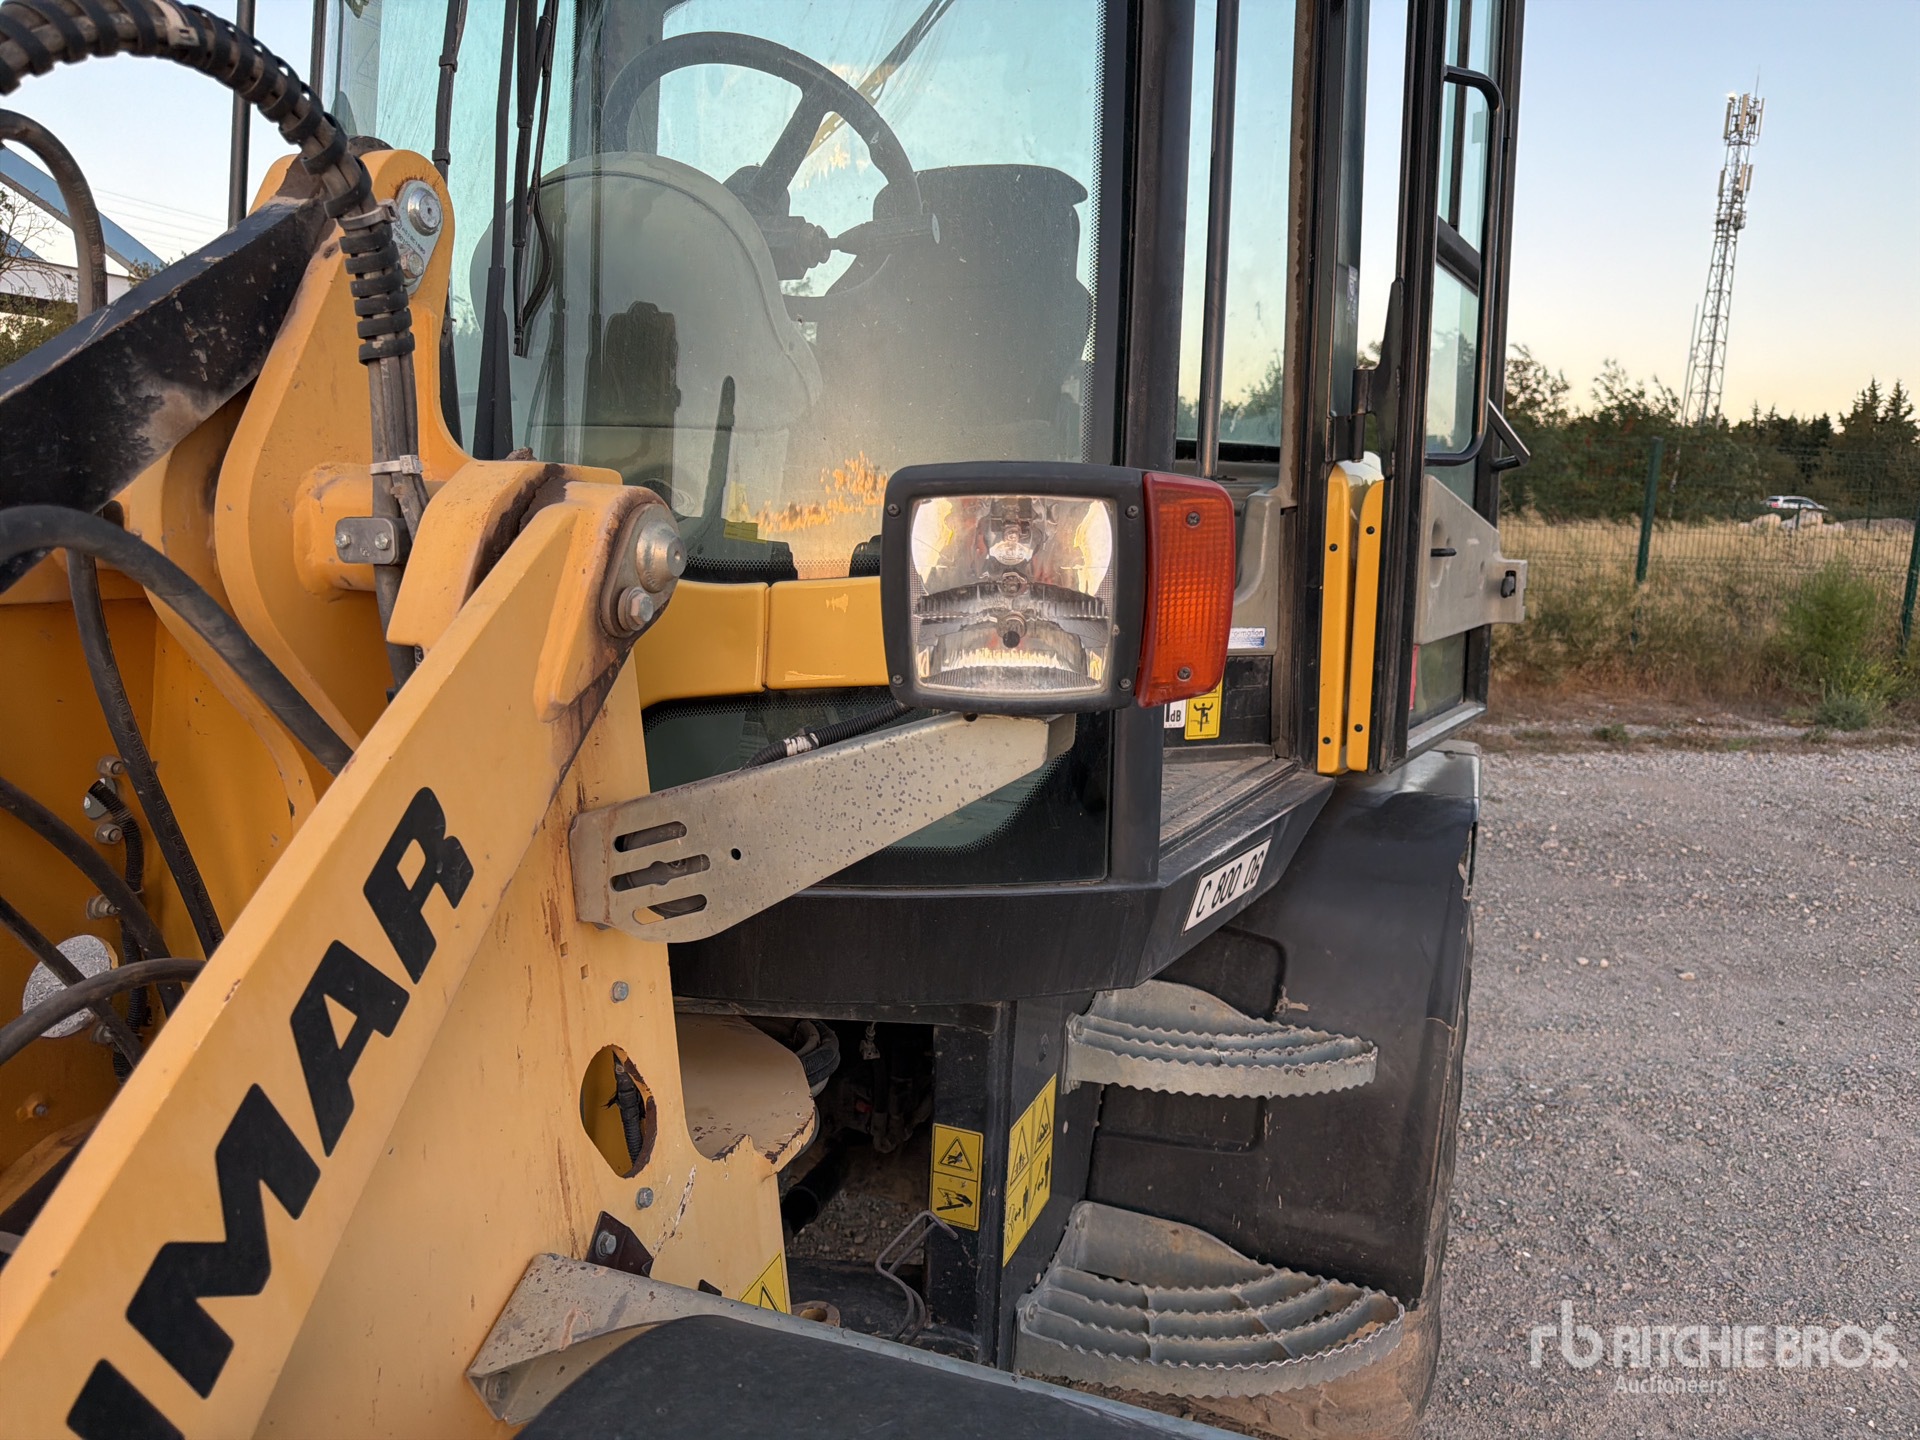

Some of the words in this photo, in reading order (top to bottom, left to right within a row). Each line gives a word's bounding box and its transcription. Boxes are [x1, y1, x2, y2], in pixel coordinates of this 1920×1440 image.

[1170, 709, 1181, 722] dB
[1196, 880, 1212, 918] C
[1211, 862, 1243, 909] 800
